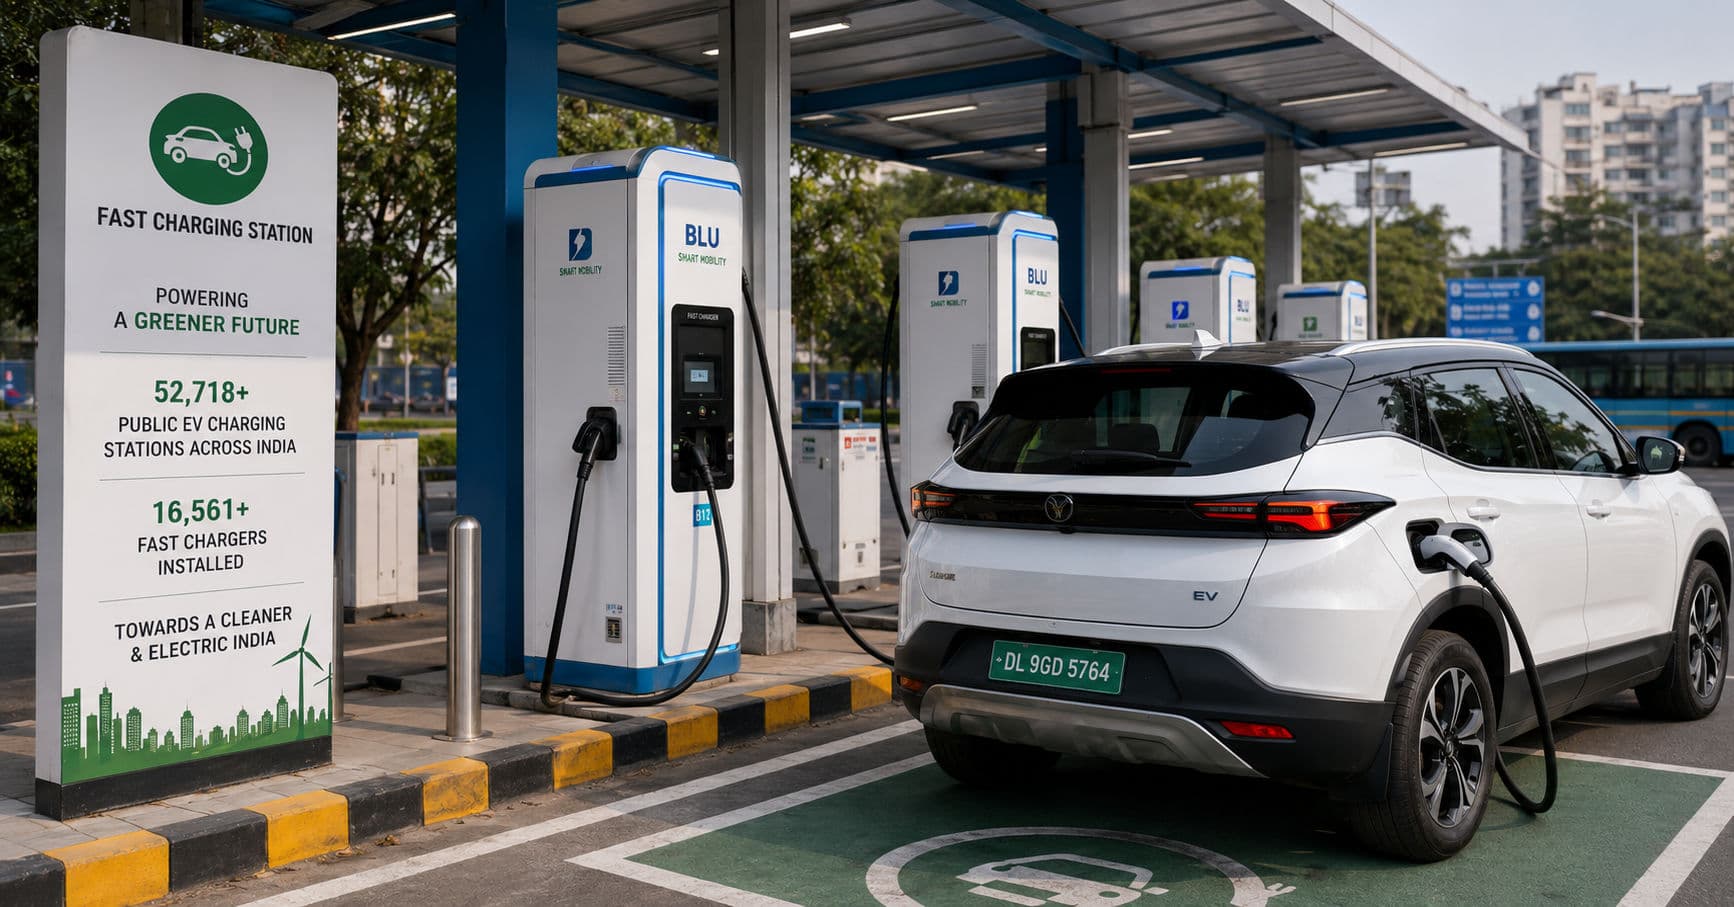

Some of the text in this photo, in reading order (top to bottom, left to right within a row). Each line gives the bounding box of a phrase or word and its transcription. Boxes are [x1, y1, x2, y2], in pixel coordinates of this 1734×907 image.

[97, 206, 313, 244] FAST CHARGING STATION
[685, 223, 720, 249] BLU
[678, 252, 727, 266] SMART MOBILITY
[1028, 267, 1048, 286] BLU
[155, 287, 249, 308] POWERING
[113, 311, 300, 336] A GREENER FUTURE
[154, 380, 249, 407] 52,718+
[118, 415, 286, 433] PUBLIC EV CHARGING
[103, 439, 297, 458] STATIONS ACROSS INDIA
[153, 498, 250, 527] 16,561+
[137, 530, 267, 553] FAST CHARGERS
[158, 554, 244, 575] INSTALLED
[1193, 590, 1219, 602] EV
[114, 605, 293, 641] TOWARDS A CLEANER
[130, 630, 276, 663] & ELECTRIC INDIA
[1003, 651, 1110, 682] DL 9GD 5764
